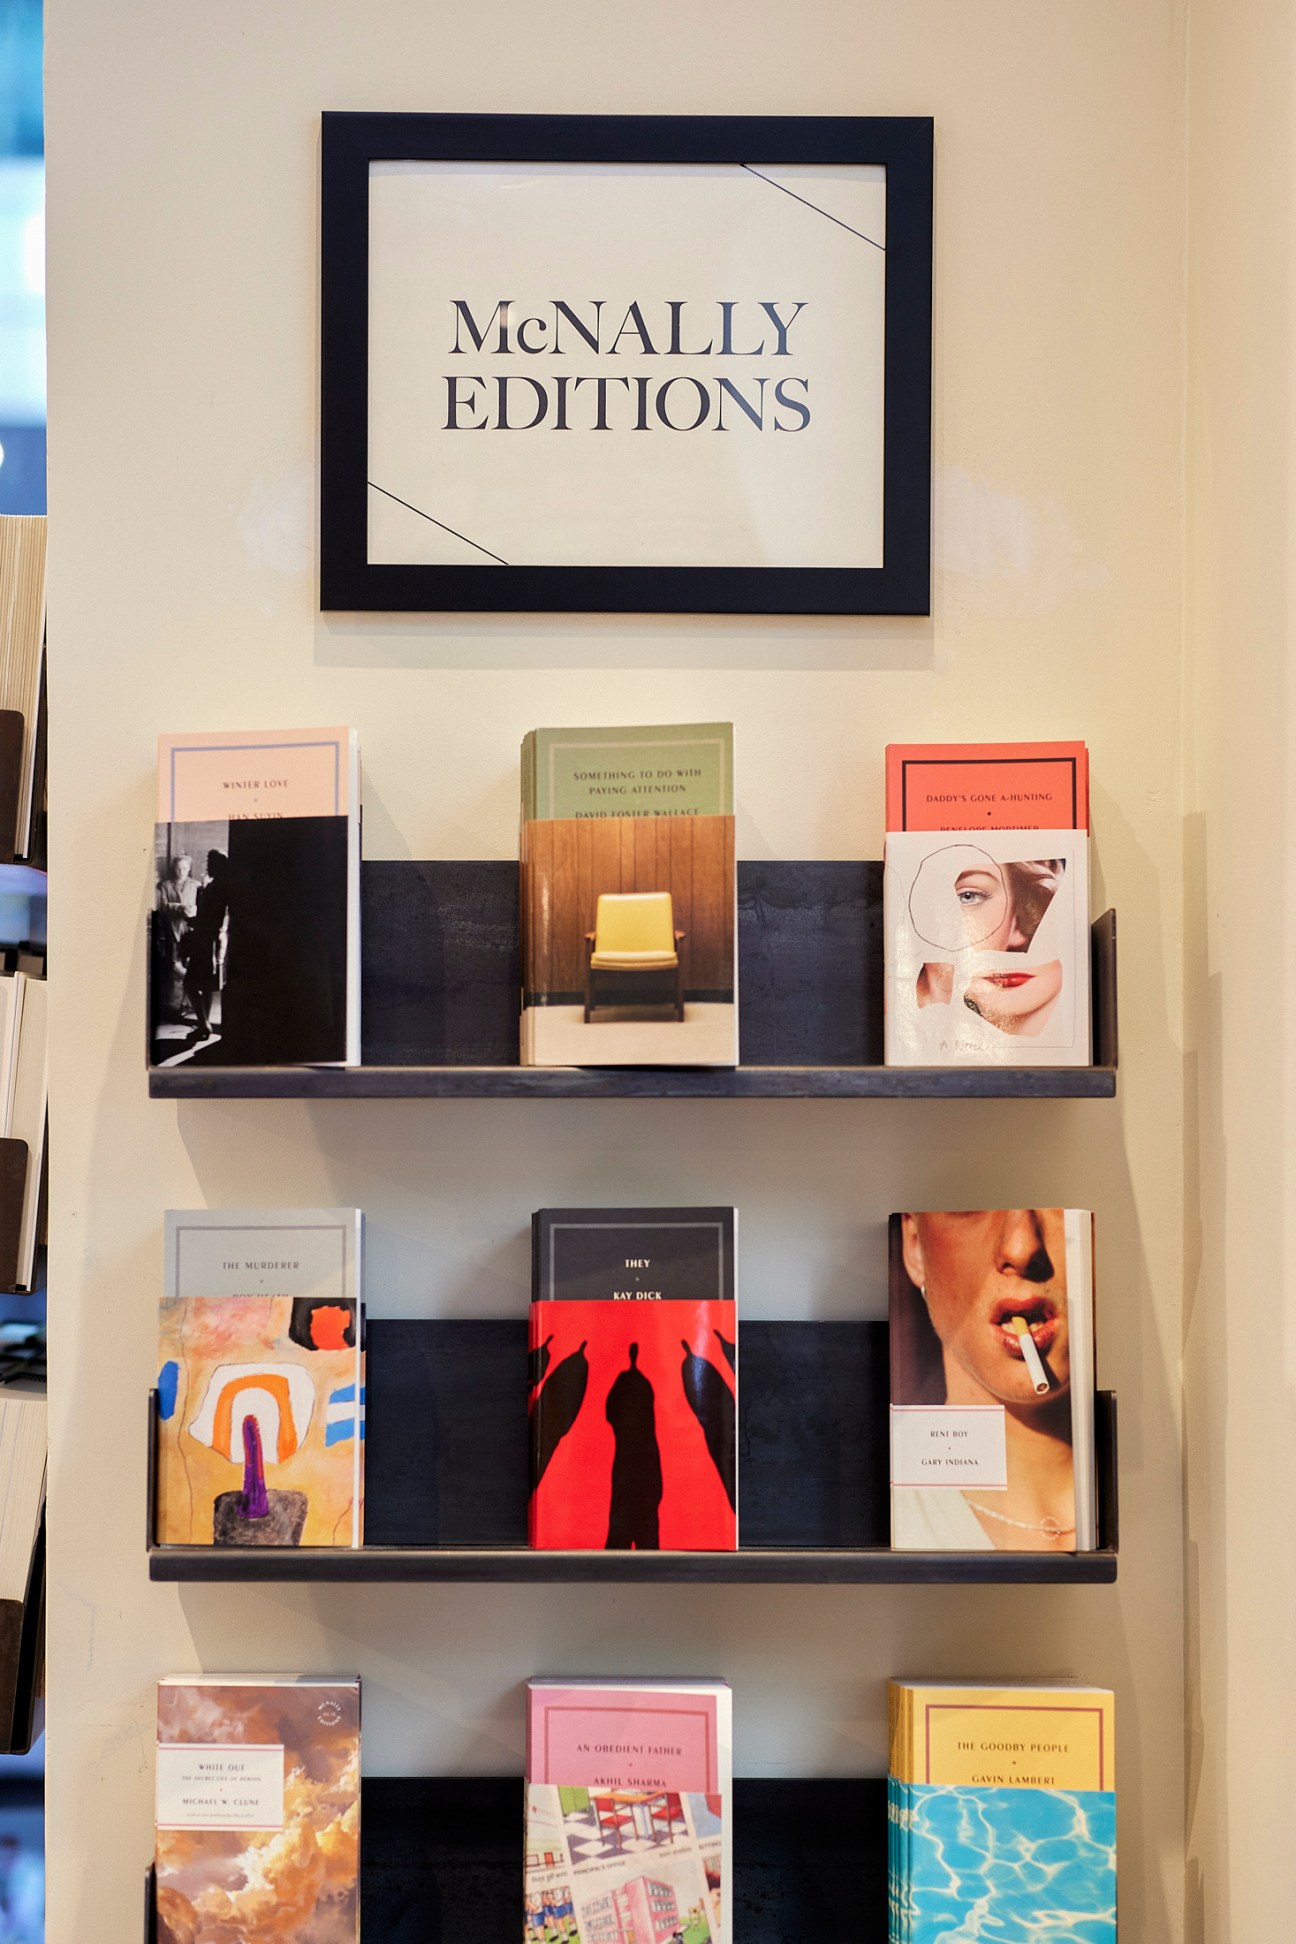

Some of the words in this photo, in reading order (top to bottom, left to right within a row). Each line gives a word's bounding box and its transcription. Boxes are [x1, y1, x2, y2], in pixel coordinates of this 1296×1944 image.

[447, 300, 810, 356] McNALLY
[441, 376, 811, 432] EDITIONS
[573, 771, 636, 781] SOMETHING
[640, 770, 652, 779] TO
[656, 769, 673, 778] DO
[676, 768, 702, 778] WITH
[222, 780, 260, 790] WINTER
[264, 779, 289, 789] LOVE
[589, 786, 627, 796] PAYING
[631, 784, 687, 794] ATTENTION
[926, 794, 967, 803] DADDY'S
[970, 793, 996, 802] GONE
[1000, 792, 1053, 802] A-HUNTING
[575, 811, 607, 819] DAVID
[611, 809, 650, 818] FOSTER
[653, 807, 699, 817] WALLACE
[222, 1261, 240, 1270] THE
[245, 1261, 300, 1270] MURDERER
[624, 1259, 650, 1268] THEY
[613, 1291, 632, 1300] KAY
[636, 1291, 662, 1300] DICK
[576, 1744, 591, 1752] AN
[594, 1745, 644, 1754] OBEDIENT
[648, 1746, 682, 1755] FATHER
[957, 1742, 976, 1750] THE
[980, 1742, 1026, 1751] GOODBY
[1030, 1744, 1069, 1753] PEOPLE
[199, 1763, 223, 1771] WHITE
[227, 1763, 245, 1771] OUT
[593, 1777, 623, 1786] AKHIL
[627, 1778, 667, 1787] SHARMA
[972, 1775, 1004, 1784] GAVIN
[1008, 1776, 1056, 1785] LAMBERT
[233, 1798, 260, 1806] CLUNE
